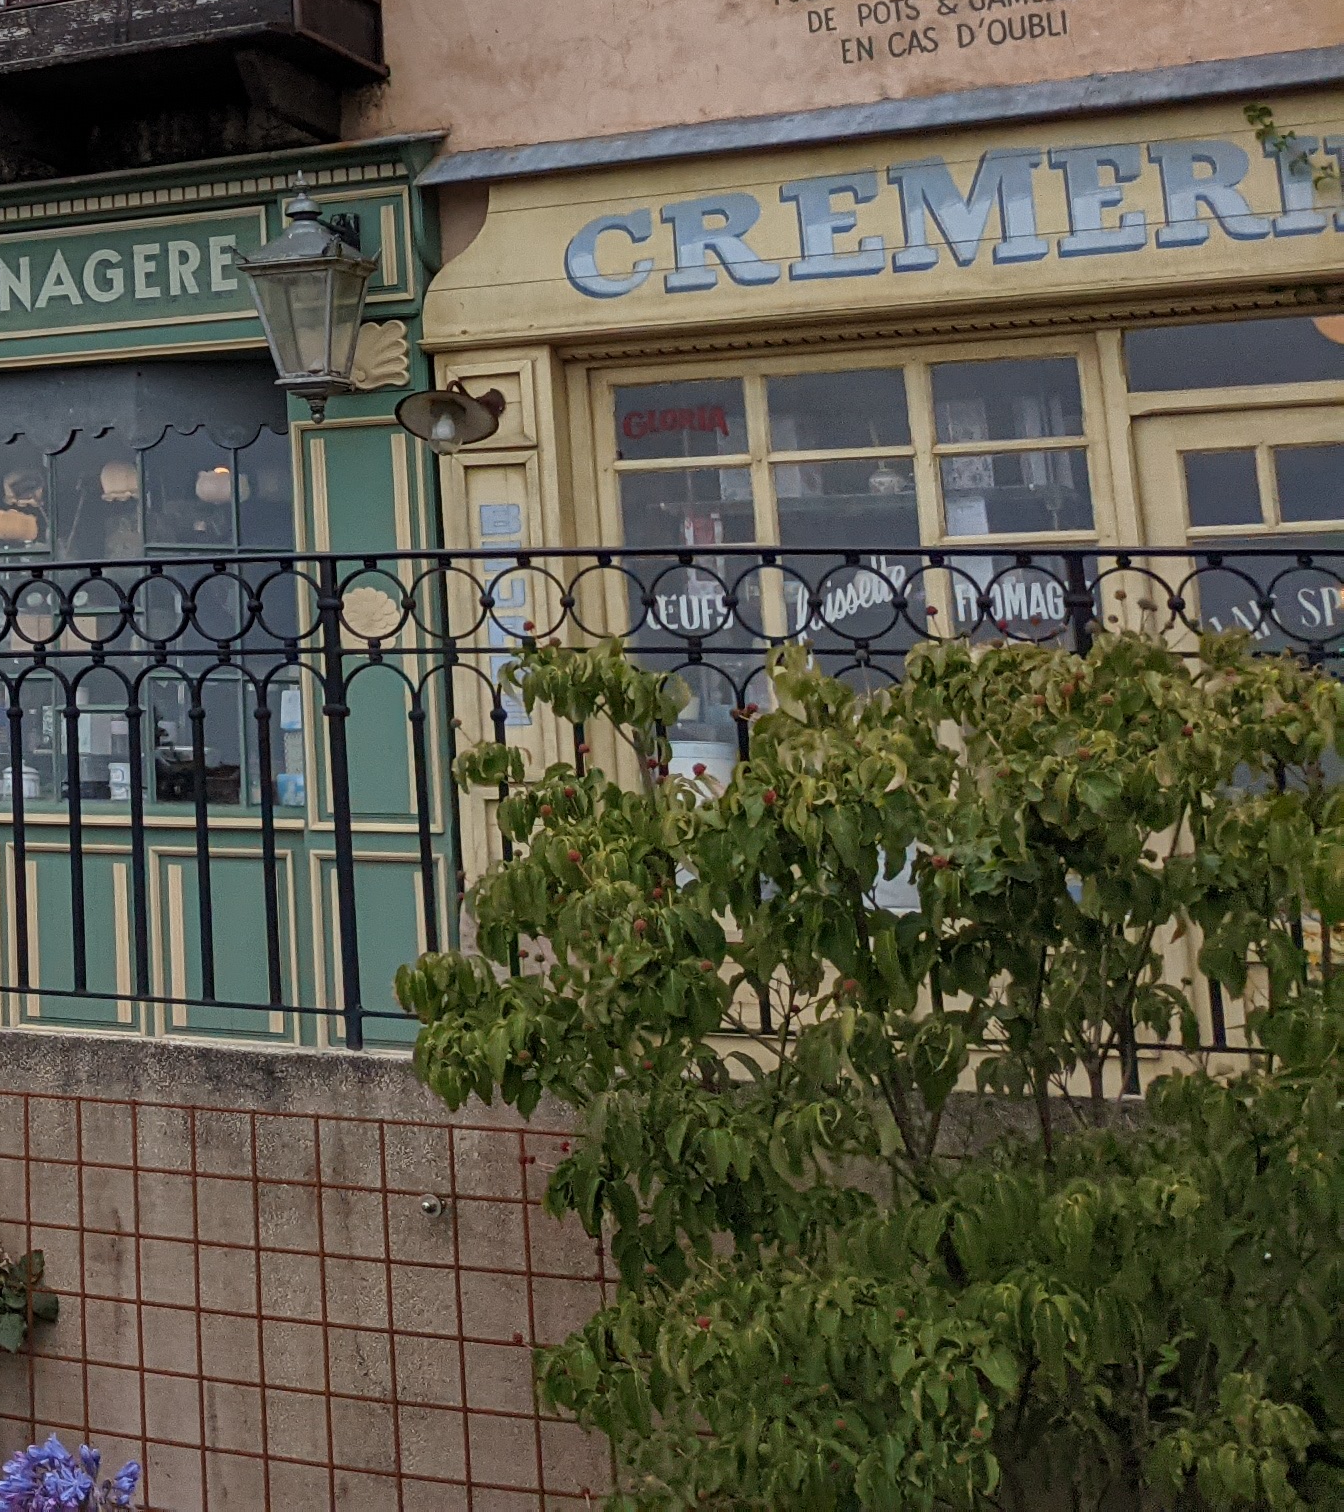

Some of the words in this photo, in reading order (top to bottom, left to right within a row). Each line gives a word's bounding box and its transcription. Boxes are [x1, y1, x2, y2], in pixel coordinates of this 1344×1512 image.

[806, 6, 837, 34] DE
[841, 37, 874, 65] EN
[887, 26, 940, 59] CAS
[957, 10, 1069, 50] D'OUBLI
[622, 406, 730, 440] GLORIA
